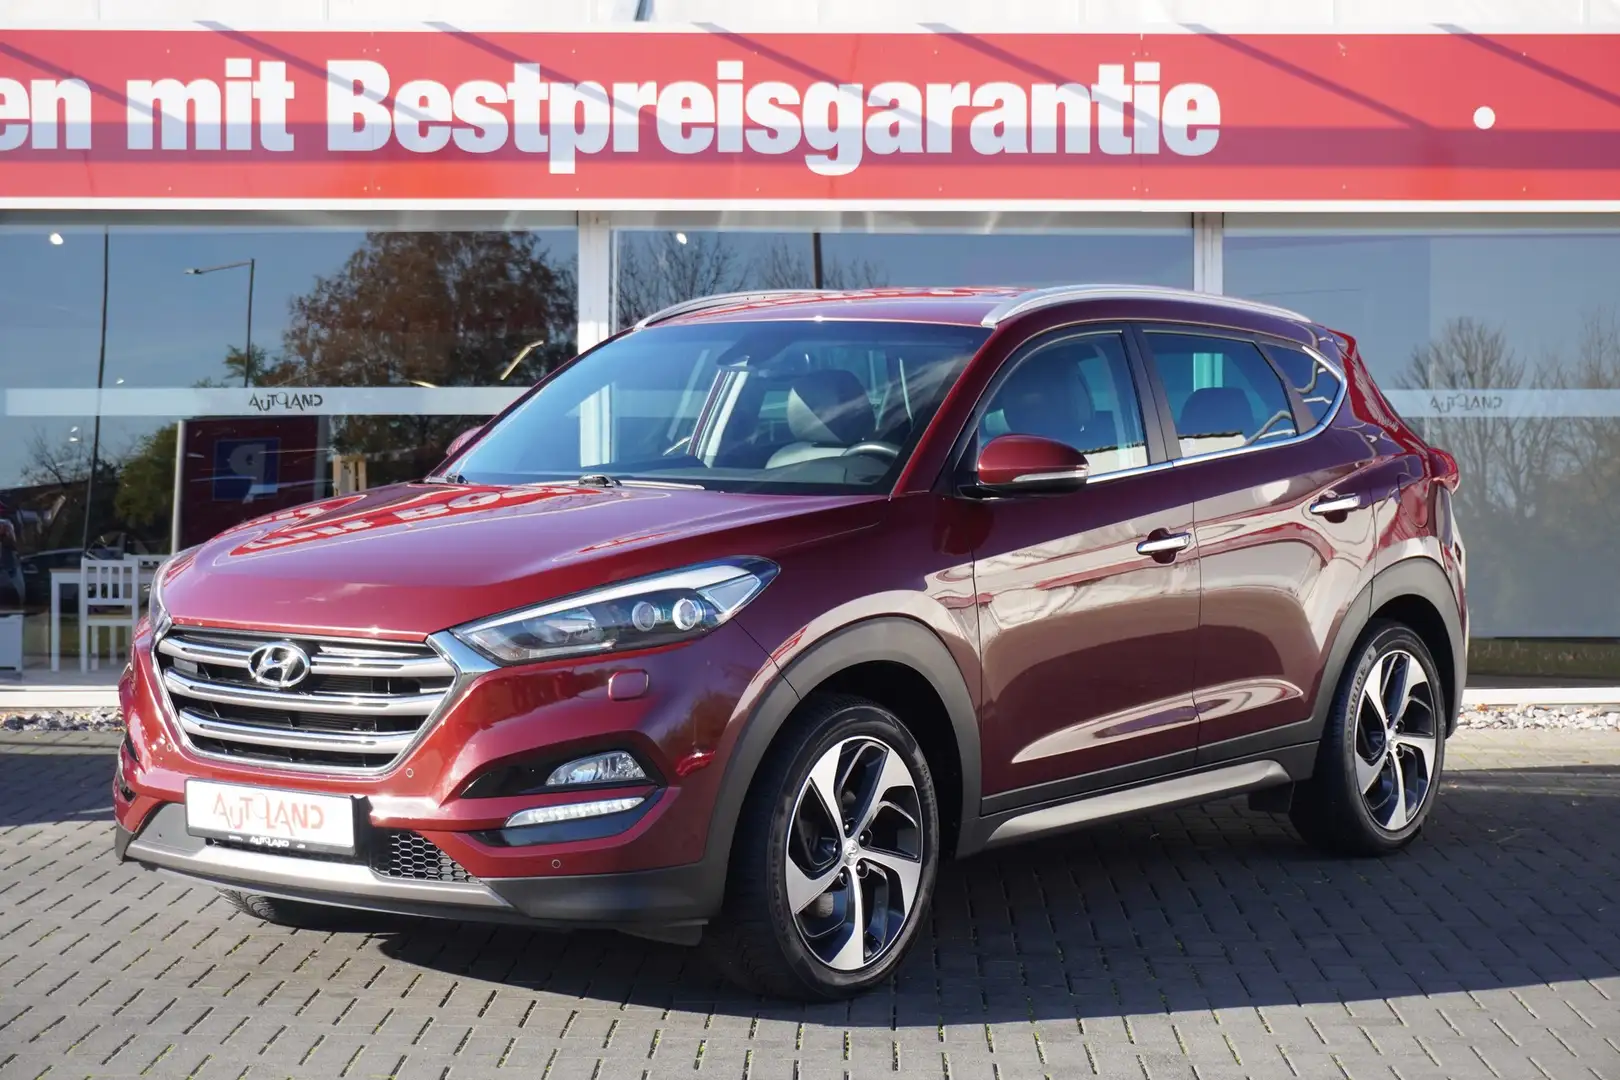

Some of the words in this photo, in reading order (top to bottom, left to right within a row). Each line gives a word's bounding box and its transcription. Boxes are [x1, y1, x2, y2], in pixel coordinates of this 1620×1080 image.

[127, 58, 294, 152] mit
[327, 59, 1221, 176] Bestpreisgarantie
[248, 392, 323, 411] AUTOLAND
[213, 792, 325, 836] AUTOLAND
